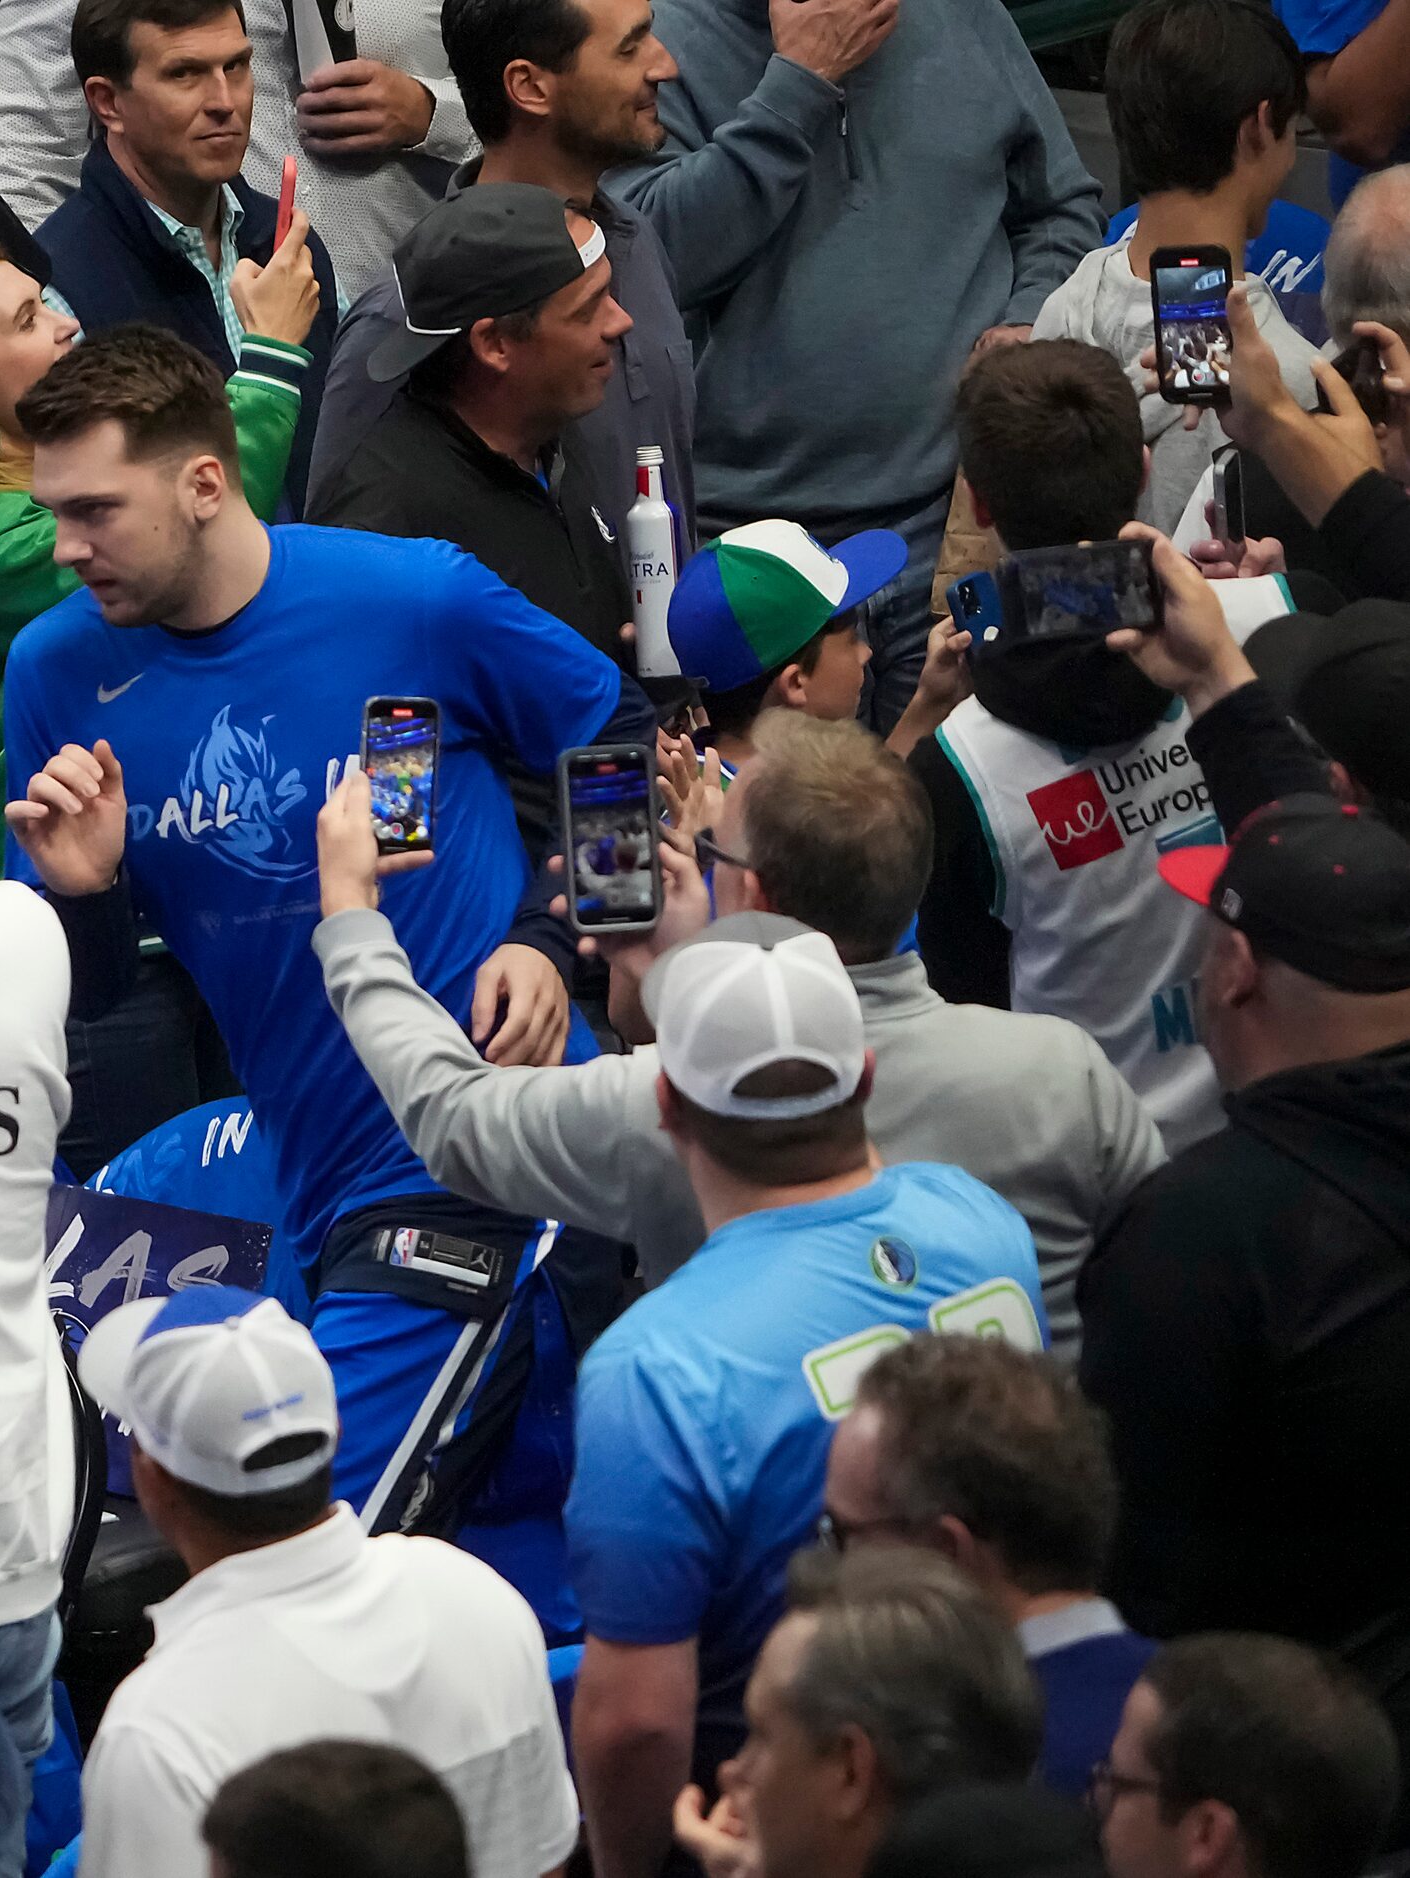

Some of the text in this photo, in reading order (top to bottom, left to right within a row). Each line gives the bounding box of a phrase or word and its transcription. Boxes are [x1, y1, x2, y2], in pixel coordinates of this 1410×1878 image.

[1261, 249, 1322, 293] IN
[631, 562, 669, 577] TRA
[1099, 744, 1189, 794] Unive
[1116, 782, 1211, 836] Europ
[202, 1109, 255, 1168] IN
